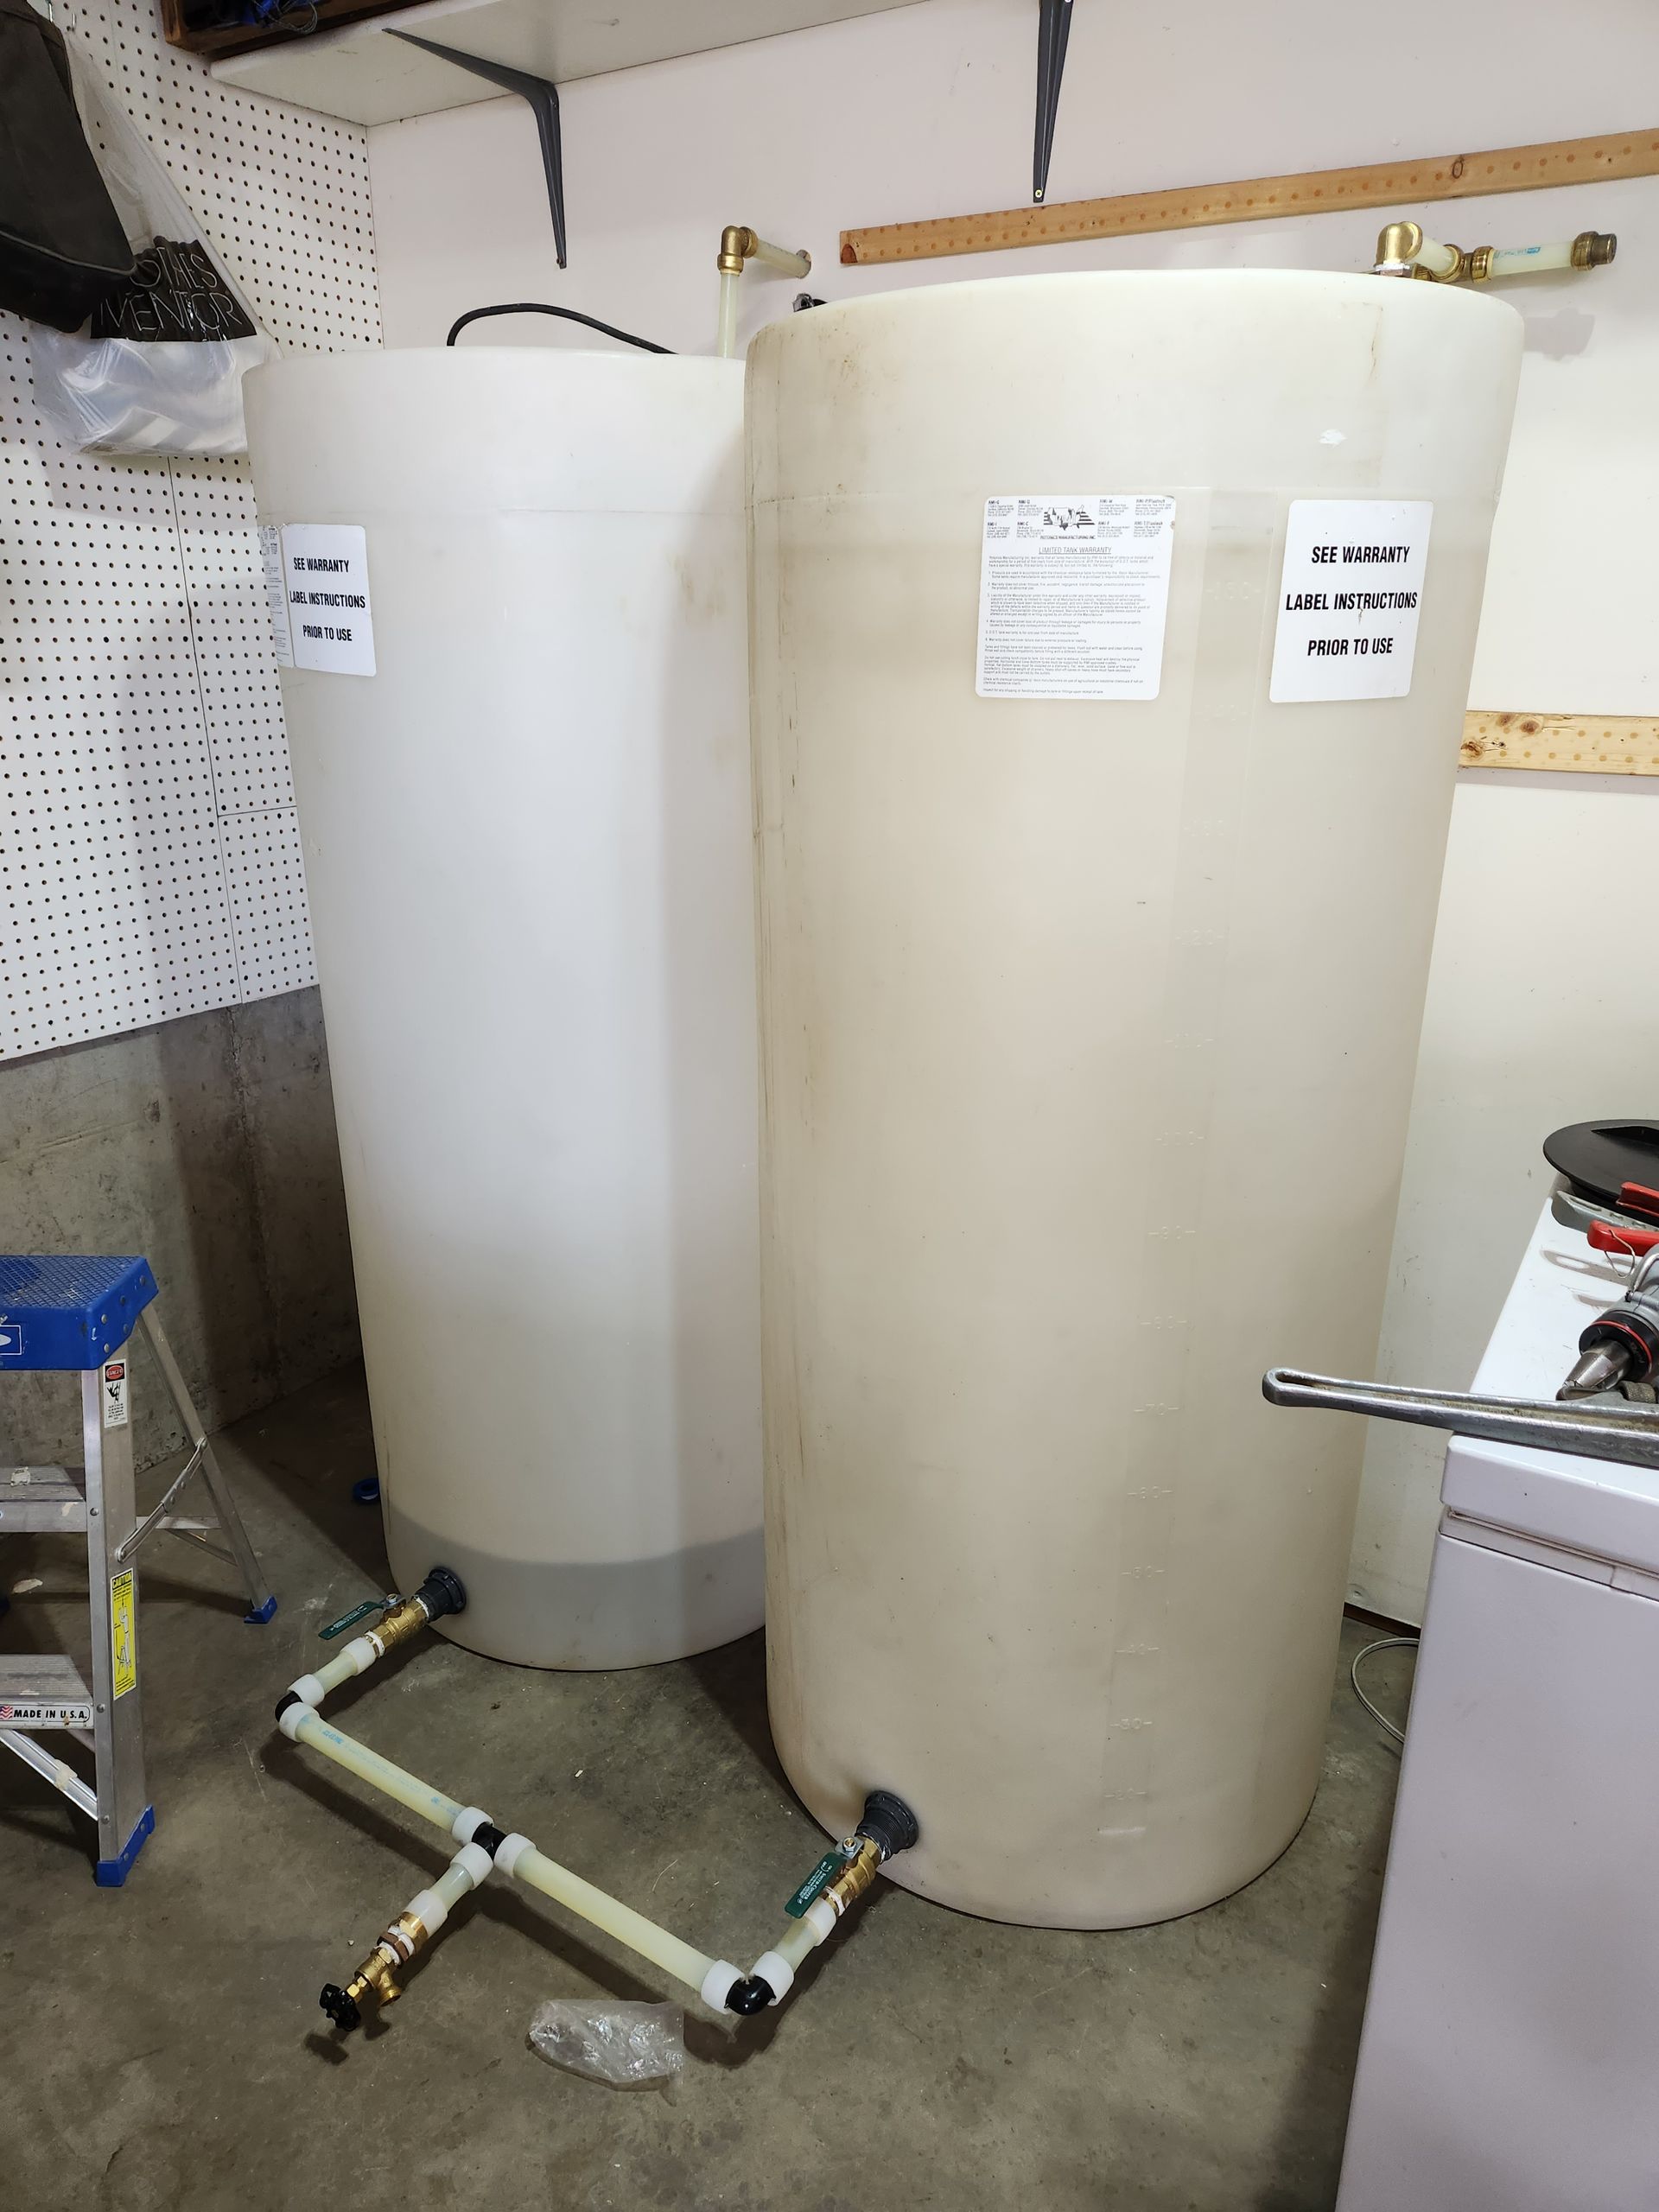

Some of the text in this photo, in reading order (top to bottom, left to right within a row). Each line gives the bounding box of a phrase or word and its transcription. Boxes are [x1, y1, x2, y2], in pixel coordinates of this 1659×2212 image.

[1312, 546, 1410, 563] SEE WARRANTY
[293, 557, 349, 572] SEE WARRANTY
[289, 590, 365, 608] LABEL INSTRUCTIONS
[1285, 592, 1418, 611] LABEL INSTRUCTIONS
[302, 625, 353, 641] PRIOR TO USE
[1307, 637, 1394, 656] PRIOR TO USE
[113, 1571, 132, 1588] CAUTION
[14, 1710, 87, 1719] MADE IN US.A.
